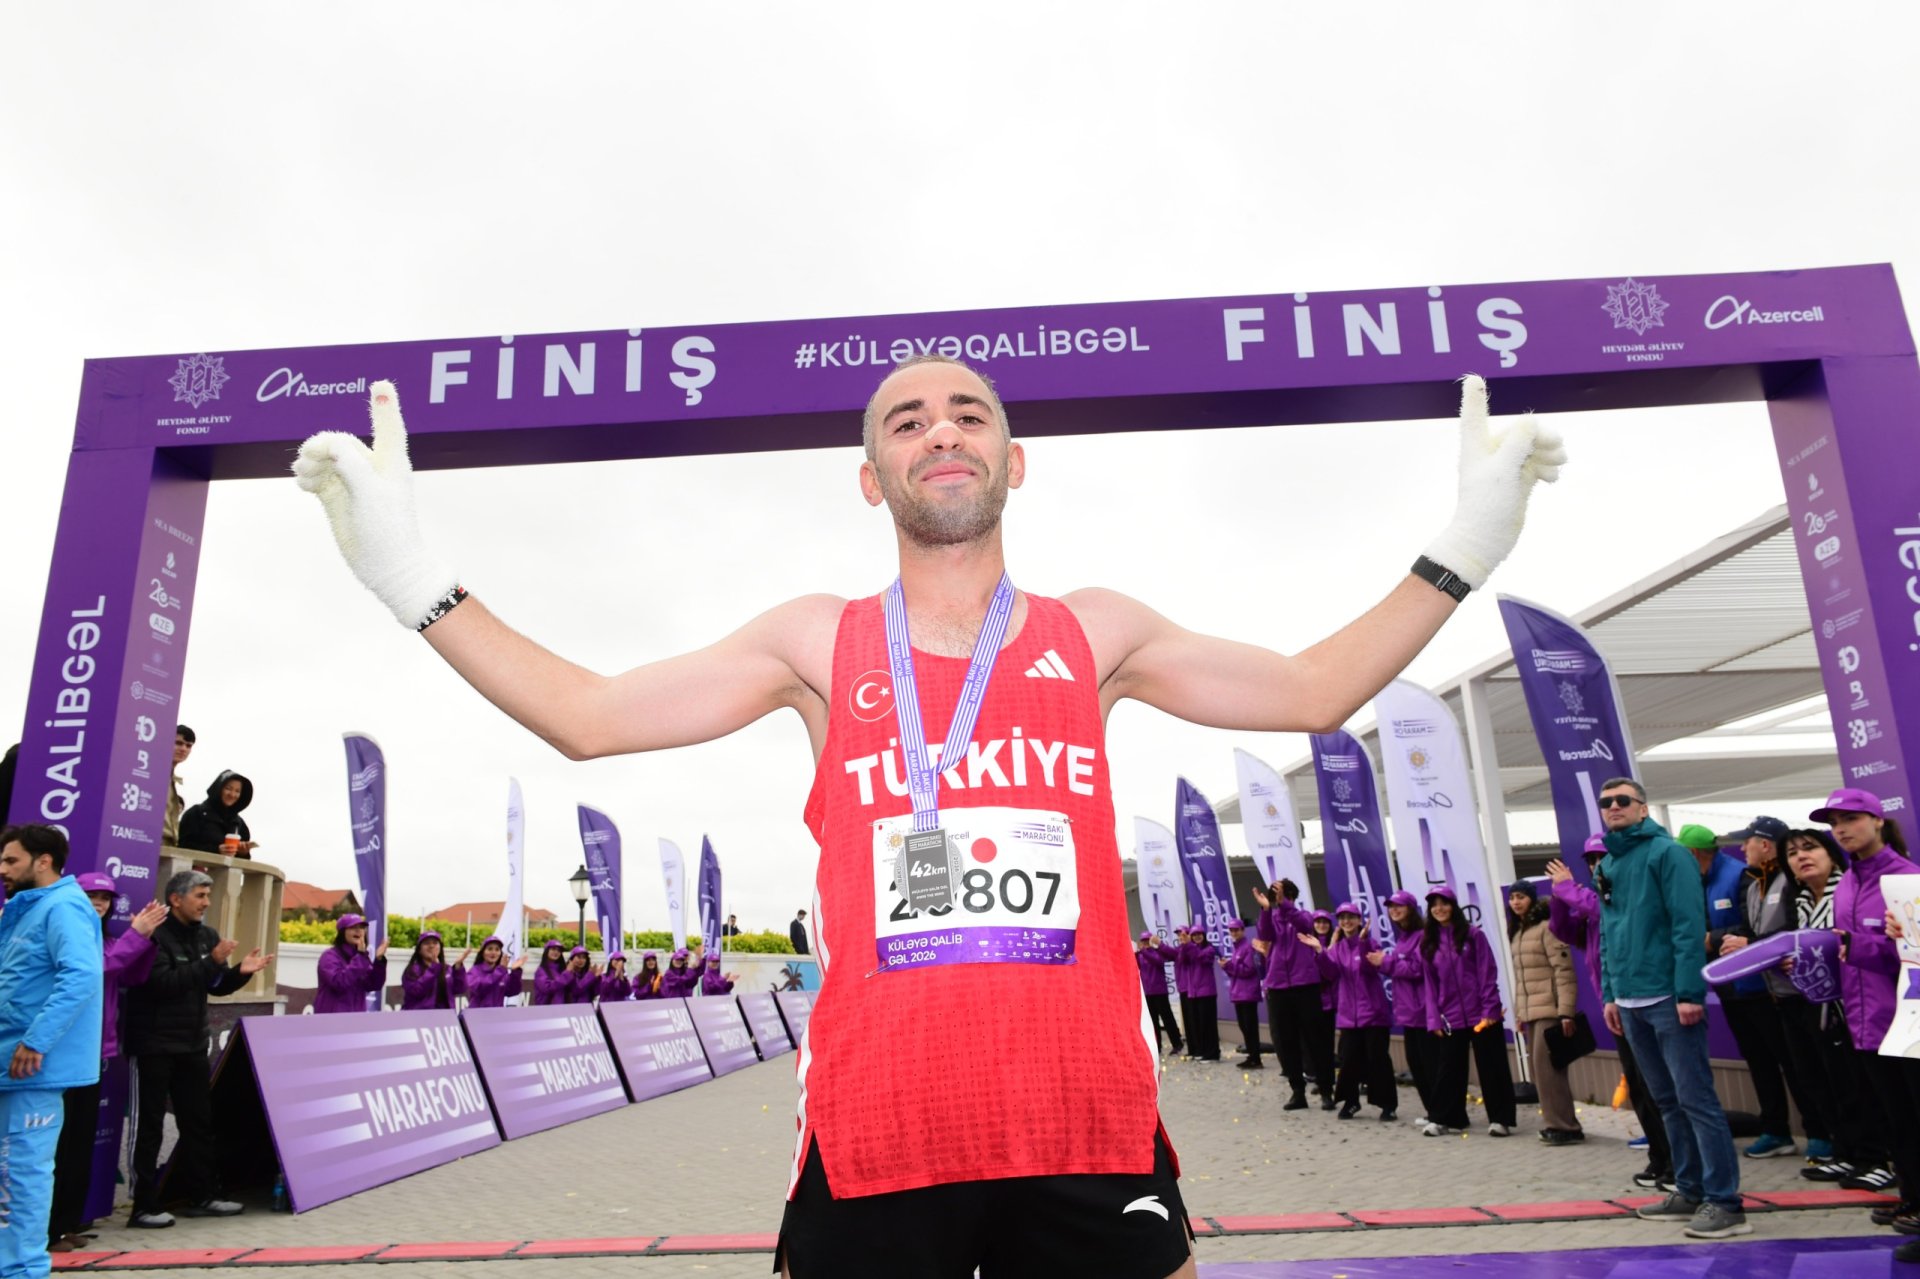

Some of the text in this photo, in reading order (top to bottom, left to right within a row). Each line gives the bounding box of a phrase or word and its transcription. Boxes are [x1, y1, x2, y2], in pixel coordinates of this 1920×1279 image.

[1748, 306, 1825, 325] Azercell
[1223, 285, 1528, 369] FİNİŞ
[794, 324, 1150, 369] #KÜLƏYƏQALİBGƏL
[1602, 342, 1685, 354] HEYDƏR ƏLİYEV
[428, 327, 717, 407] FİNİŞ
[1626, 353, 1664, 363] FONDU
[294, 377, 367, 397] Azercell
[156, 415, 232, 427] HEYDƏR ƏLİYEV
[176, 427, 210, 435] FONDU
[153, 616, 171, 632] AZE
[966, 664, 987, 703] BAKU MARATHON
[844, 726, 1096, 807] TÜRKİYE
[908, 751, 932, 793] MARATHON BAKU
[1851, 764, 1873, 779] TAN
[111, 825, 132, 839] TAN
[1022, 831, 1065, 843] MARAFONU
[1046, 824, 1065, 834] BAKI
[910, 860, 947, 878] 42km
[889, 867, 1062, 923] 2807
[887, 937, 928, 953] KÜLƏYƏ
[929, 932, 964, 947] QALİB
[888, 950, 937, 966] GƏL 2026
[568, 1014, 606, 1048] BAKI
[419, 1024, 471, 1068] BAKI
[649, 1036, 705, 1071] MARAFONU
[536, 1049, 618, 1095] MARAFONU
[363, 1071, 487, 1137] MARAFONU
